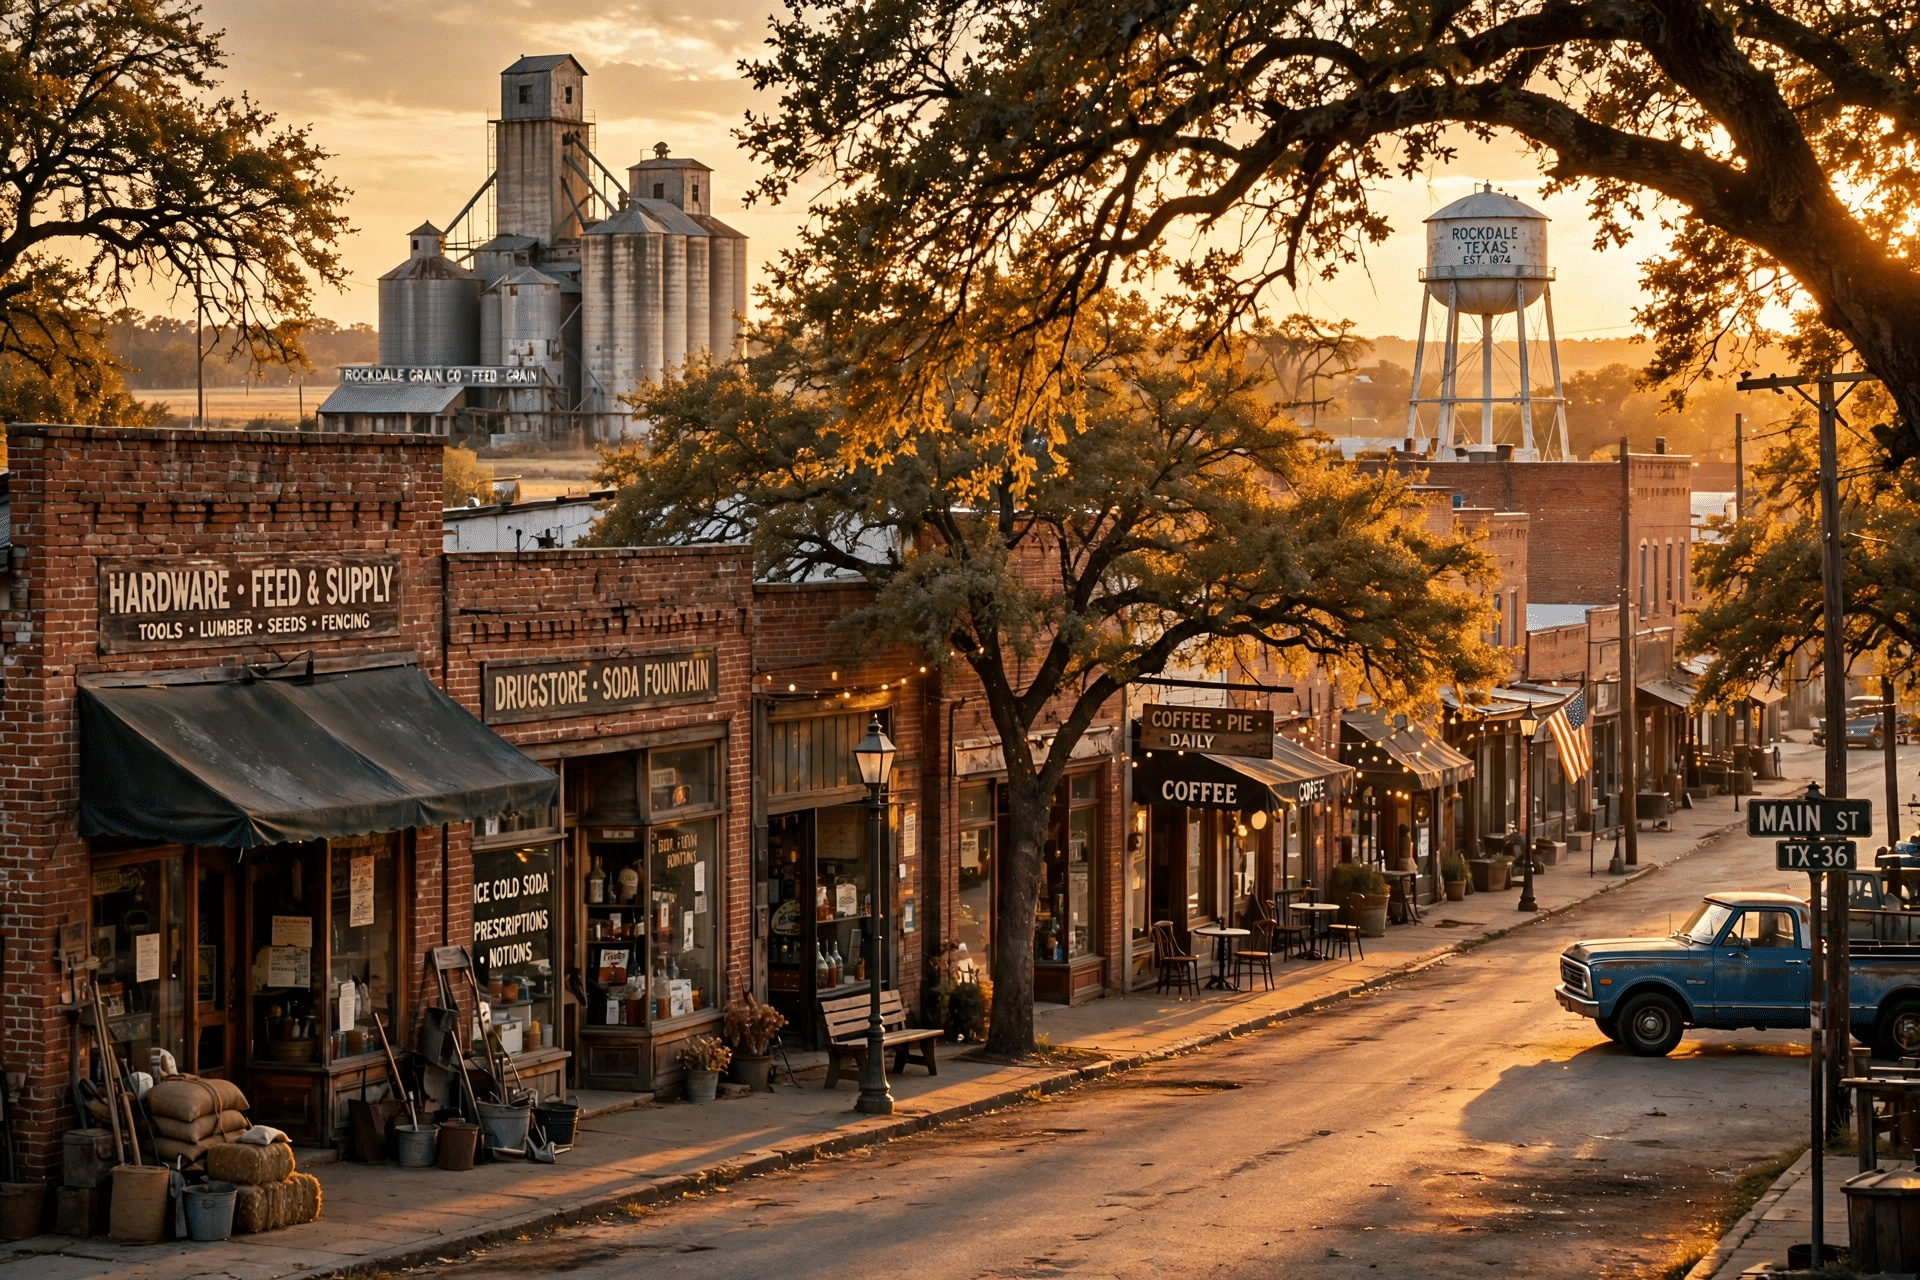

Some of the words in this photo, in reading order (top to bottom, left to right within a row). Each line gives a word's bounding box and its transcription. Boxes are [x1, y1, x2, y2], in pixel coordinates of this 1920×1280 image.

[1452, 226, 1518, 240] ROCKDALE
[1463, 255, 1485, 265] EST.
[1489, 254, 1511, 264] 1874
[1464, 241, 1508, 254] TEXAS
[344, 368, 405, 382] ROCKDALE
[409, 368, 442, 383] GRAIN
[109, 569, 231, 614] HARDWARE
[251, 567, 301, 608] FEED
[307, 569, 320, 606] &
[325, 565, 394, 605] SUPPLY
[138, 621, 183, 641] TOOLS
[199, 618, 253, 638] LUMBER
[267, 615, 307, 634] SEEDS
[321, 612, 370, 632] FENCING
[495, 669, 588, 711] DRUGSTORE
[602, 665, 640, 701] SODA
[644, 658, 709, 696] FOUNTAIN
[1151, 710, 1212, 730] COFFEE
[1227, 713, 1254, 732] PIE
[1169, 733, 1216, 749] DAILY
[1162, 780, 1238, 805] COFFEE
[1759, 804, 1821, 832] MAIN
[1836, 811, 1860, 831] ST
[1784, 844, 1848, 867] TX-36
[474, 881, 490, 904] ICE
[493, 877, 520, 901] COLD
[522, 872, 549, 896] SODA
[474, 909, 549, 942] PRESCRIPTIONS
[489, 941, 533, 969] NOTIONS
